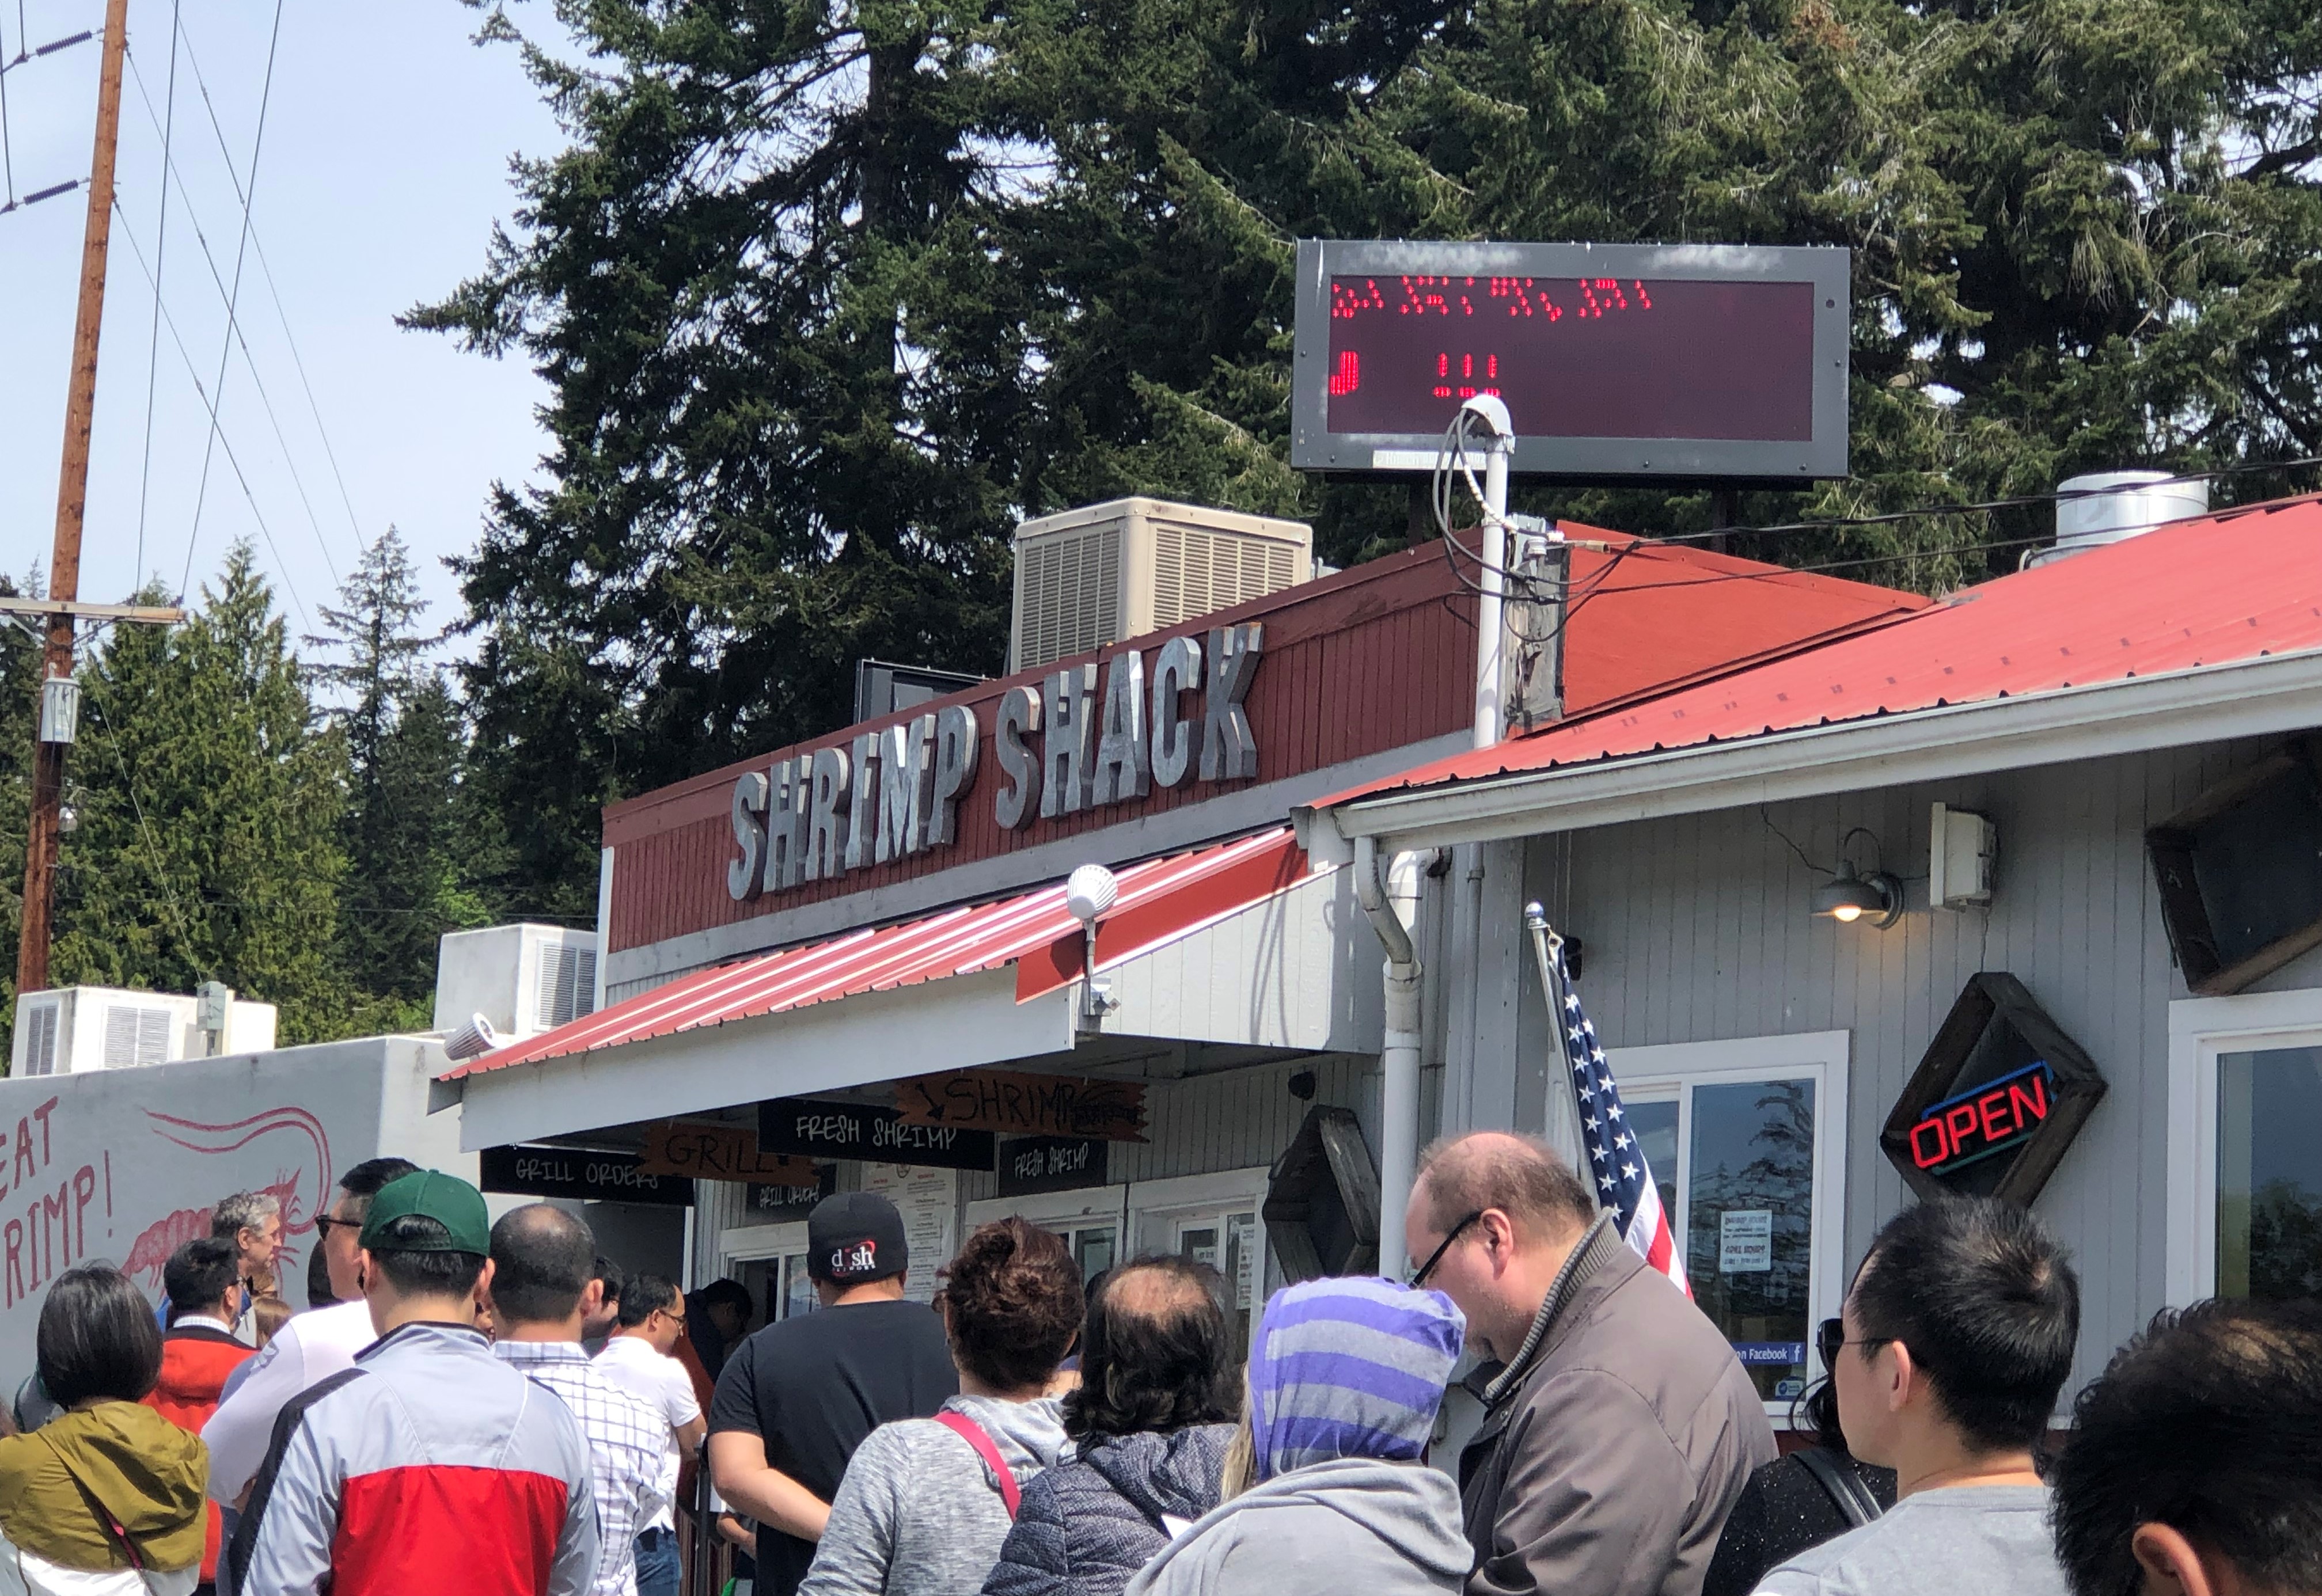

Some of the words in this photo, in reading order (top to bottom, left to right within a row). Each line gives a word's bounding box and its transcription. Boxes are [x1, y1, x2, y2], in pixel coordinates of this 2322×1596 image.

[728, 705, 980, 902] SHRIMP
[995, 622, 1265, 831] SHACK
[944, 1077, 1075, 1131] SHRIMP
[1909, 1074, 2049, 1169] OPEN
[796, 1115, 860, 1143] FRESH
[872, 1118, 957, 1150] SHRIMP
[516, 1158, 575, 1181] GRILL
[664, 1134, 774, 1173] GRILL
[1015, 1148, 1044, 1180] FRESH
[1048, 1142, 1089, 1175] SHRIMP
[1749, 1347, 1788, 1360] Facebook
